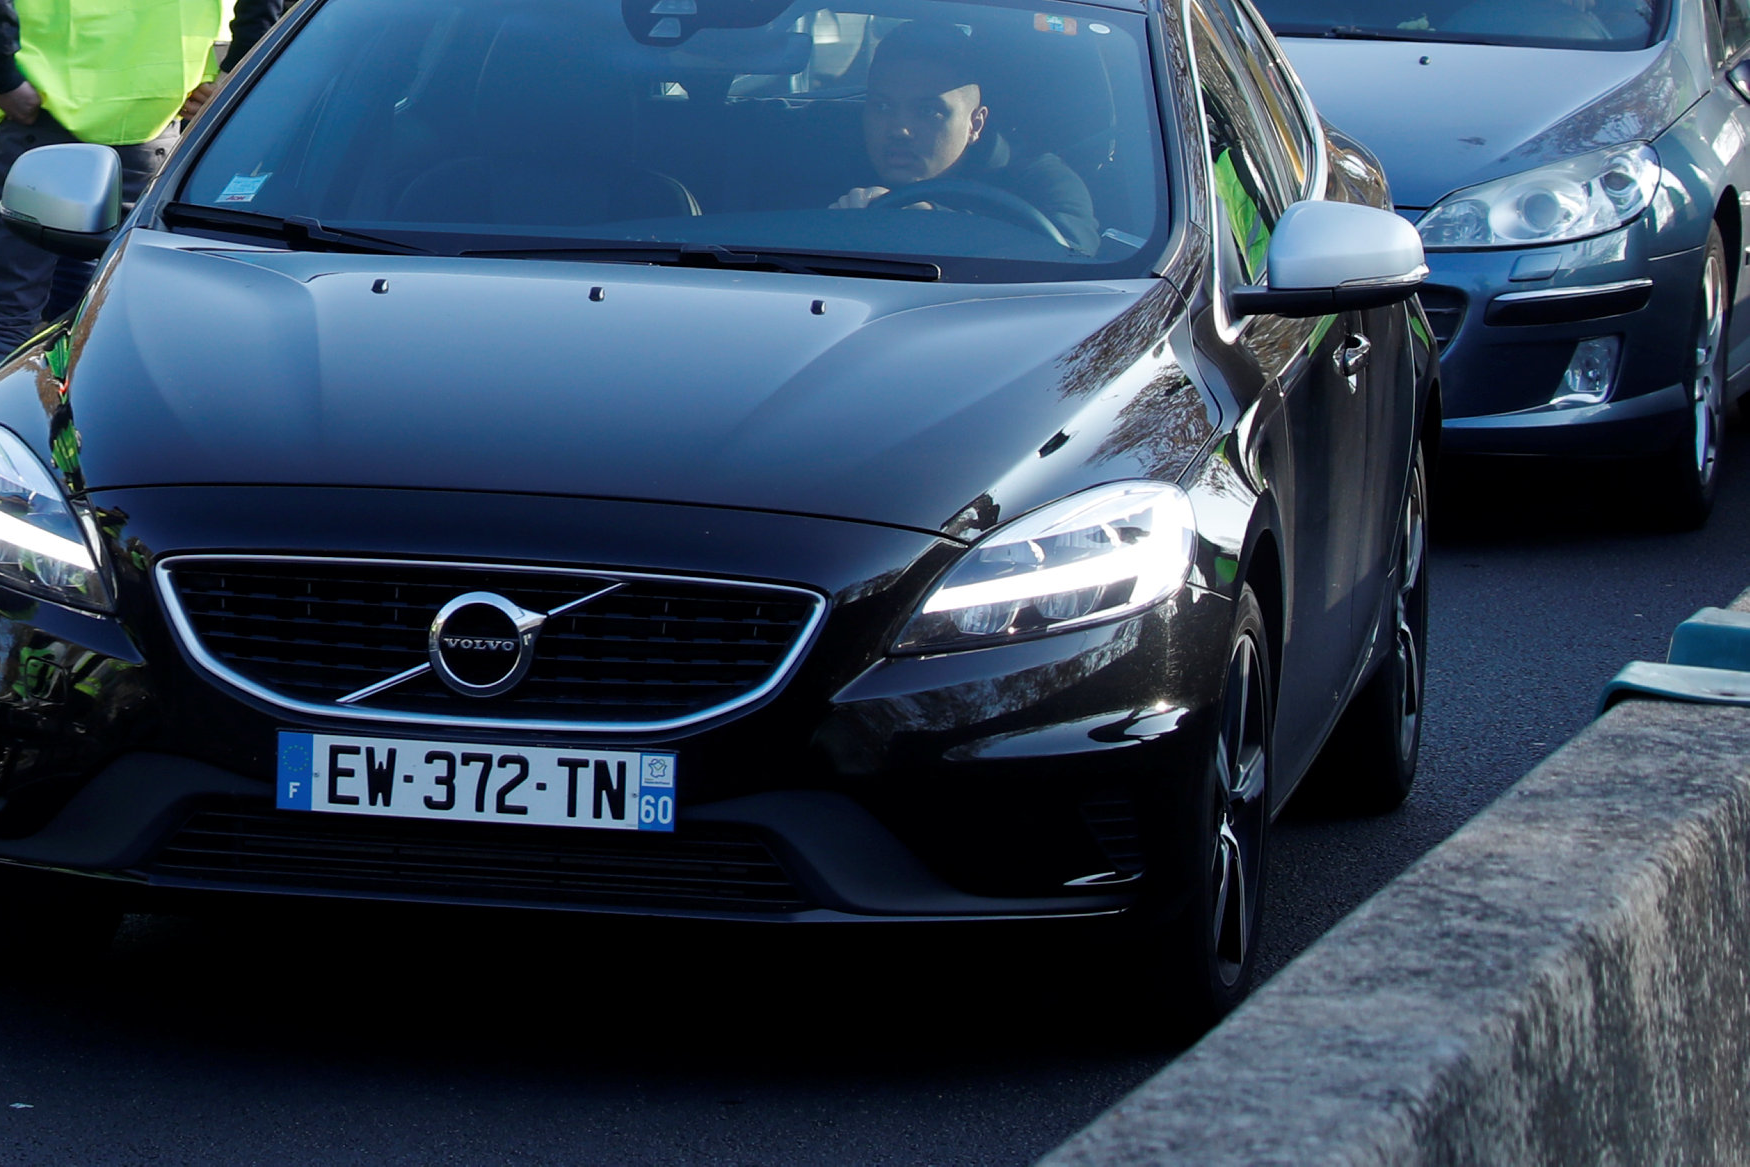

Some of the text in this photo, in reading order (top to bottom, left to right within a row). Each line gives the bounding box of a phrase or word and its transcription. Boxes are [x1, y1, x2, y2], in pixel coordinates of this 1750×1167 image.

[443, 637, 515, 653] VOLVO
[288, 781, 300, 799] F
[327, 743, 627, 821] EW-372-TN
[640, 794, 673, 825] 60
